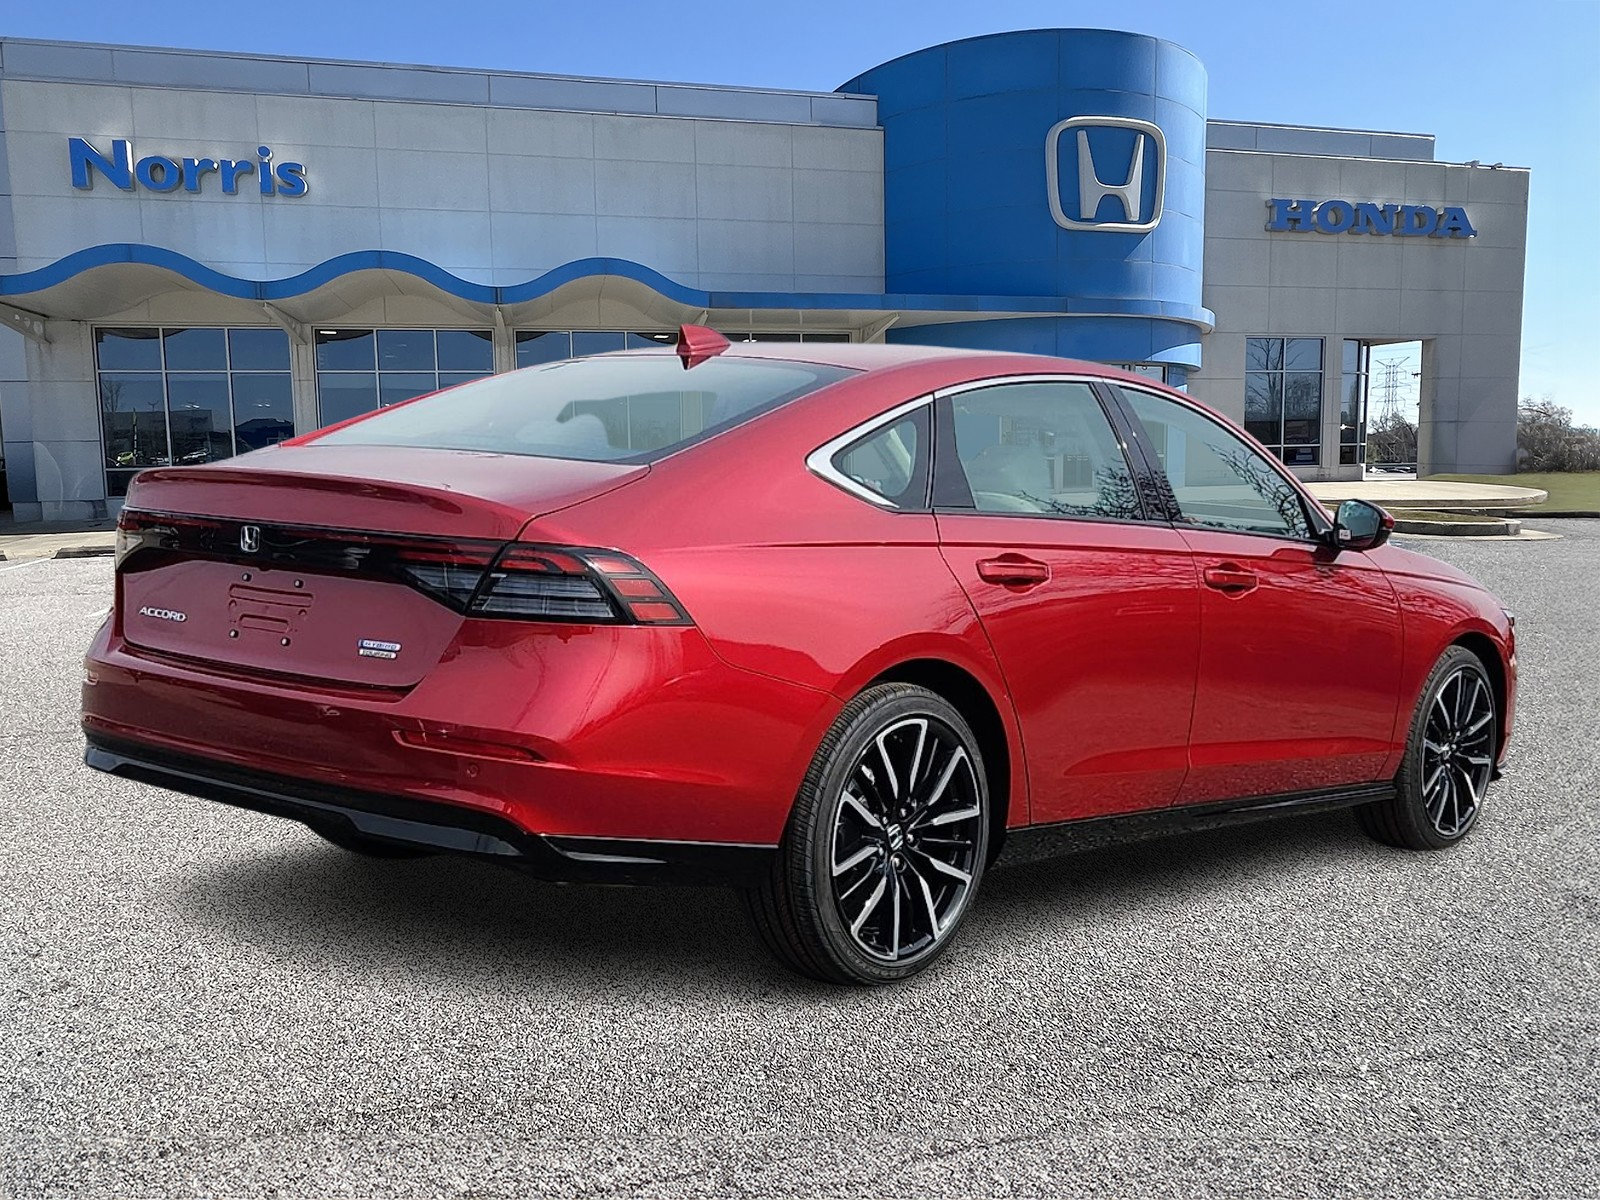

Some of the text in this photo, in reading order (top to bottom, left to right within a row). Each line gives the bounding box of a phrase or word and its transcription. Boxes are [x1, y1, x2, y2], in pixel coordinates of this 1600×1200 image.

[68, 137, 308, 197] Norris
[1265, 198, 1478, 239] HONDA
[139, 606, 186, 622] ACCORD
